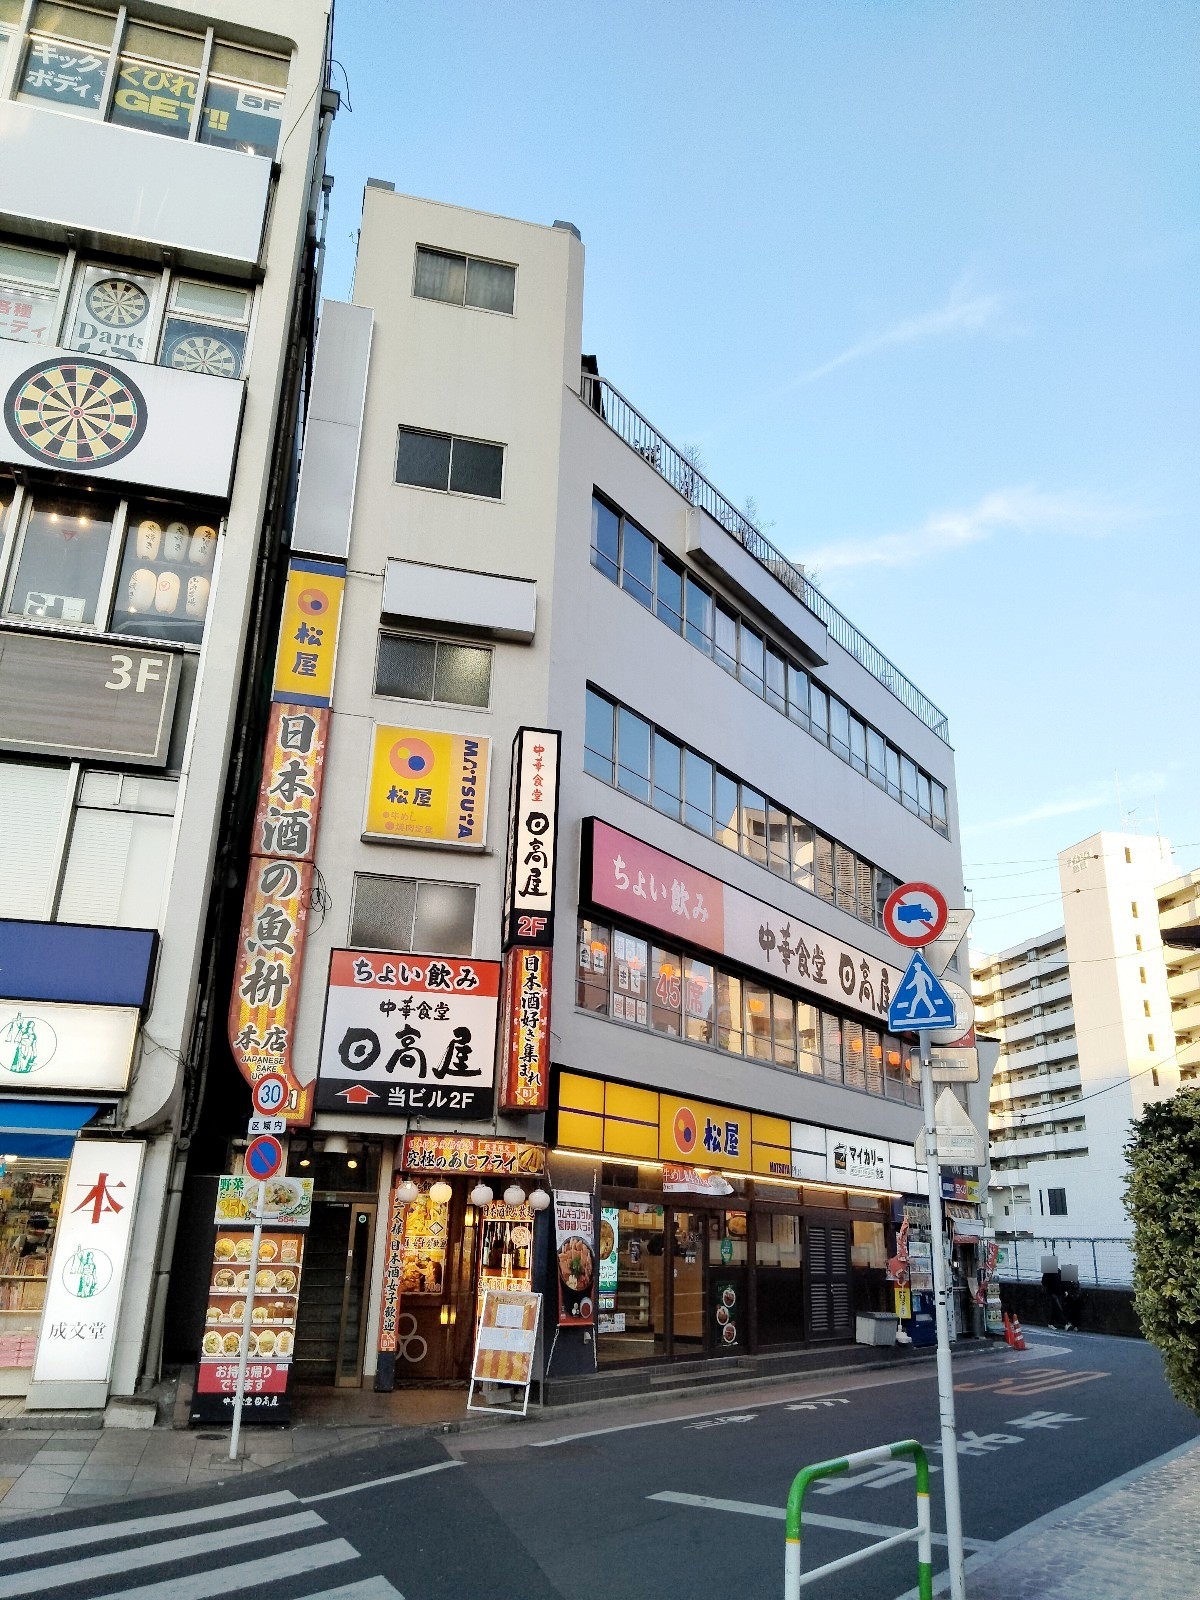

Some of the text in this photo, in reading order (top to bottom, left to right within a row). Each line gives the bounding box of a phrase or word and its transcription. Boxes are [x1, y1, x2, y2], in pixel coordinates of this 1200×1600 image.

[120, 66, 197, 98] くびれ
[241, 93, 283, 112] 5F
[78, 321, 144, 350] Darts
[291, 621, 324, 677] 松屋
[104, 654, 163, 693] 3F
[531, 743, 546, 803] 中華食堂
[386, 784, 433, 808] 松屋
[457, 739, 479, 839] MATSUYA
[518, 811, 550, 898] 日高屋
[612, 854, 709, 924] ちょい飲み
[517, 915, 548, 938] 2F
[758, 921, 828, 985] 中華食堂
[354, 959, 479, 989] ちょい飲み
[838, 952, 892, 1015] 日高屋
[379, 995, 451, 1021] 中華食堂
[519, 955, 542, 1087] 日本酒好き集まれ
[236, 1024, 287, 1053] 本店
[338, 1023, 482, 1079] 日高屋
[241, 1055, 286, 1065] JAPANESE
[255, 1065, 278, 1074] SAKE
[260, 1084, 282, 1104] 30
[388, 1086, 475, 1109] 当ビル2F
[251, 1120, 284, 1131] 区域内
[703, 1117, 740, 1157] 松屋
[406, 1150, 518, 1172] 究極のあじフライ
[70, 1172, 127, 1224] 本
[220, 1178, 245, 1191] 野菜
[48, 1321, 107, 1341] 成文堂
